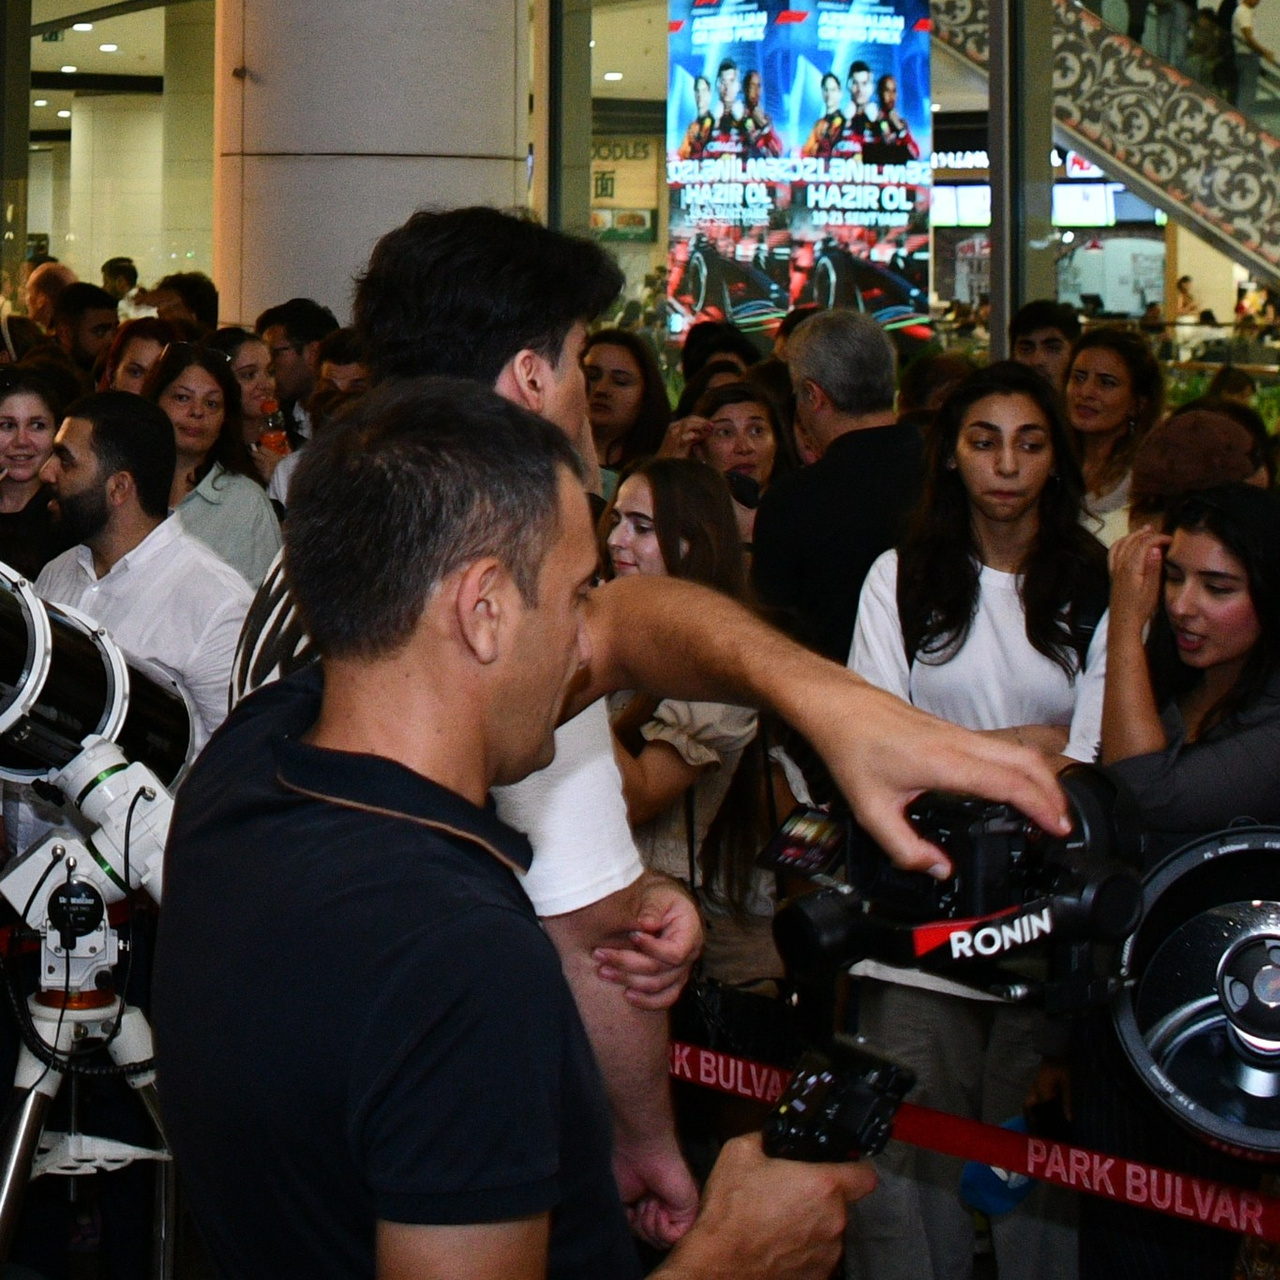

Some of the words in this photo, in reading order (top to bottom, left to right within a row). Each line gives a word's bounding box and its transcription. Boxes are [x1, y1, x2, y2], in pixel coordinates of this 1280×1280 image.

[807, 184, 880, 209] HAZIR
[881, 186, 914, 210] OL
[949, 907, 1052, 959] RONIN
[699, 1050, 791, 1102] BULVA
[1027, 1138, 1116, 1196] PARK
[1126, 1162, 1264, 1236] BULVAR
